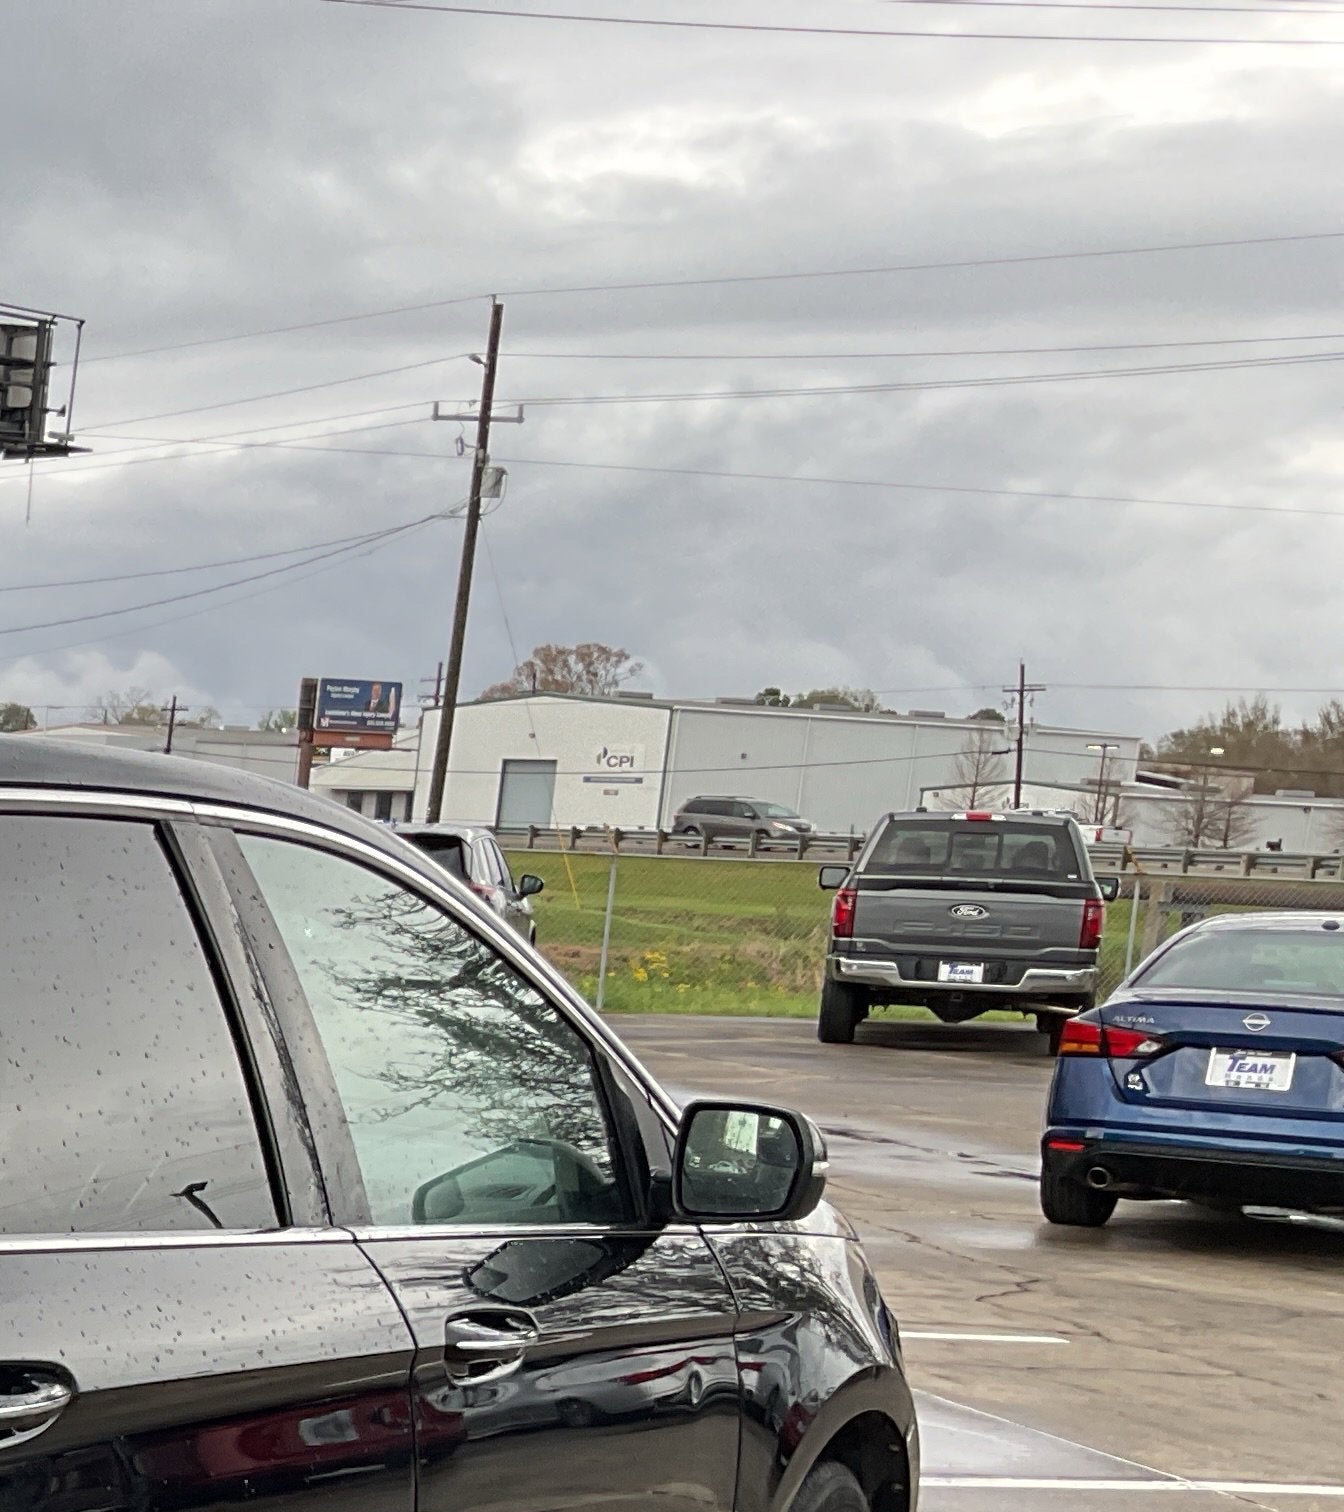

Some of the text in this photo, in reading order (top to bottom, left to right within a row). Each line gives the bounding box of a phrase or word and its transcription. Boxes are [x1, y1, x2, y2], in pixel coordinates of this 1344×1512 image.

[607, 755, 634, 768] CPI
[1112, 1014, 1155, 1024] ALTIMA
[1227, 1054, 1277, 1075] TEAM
